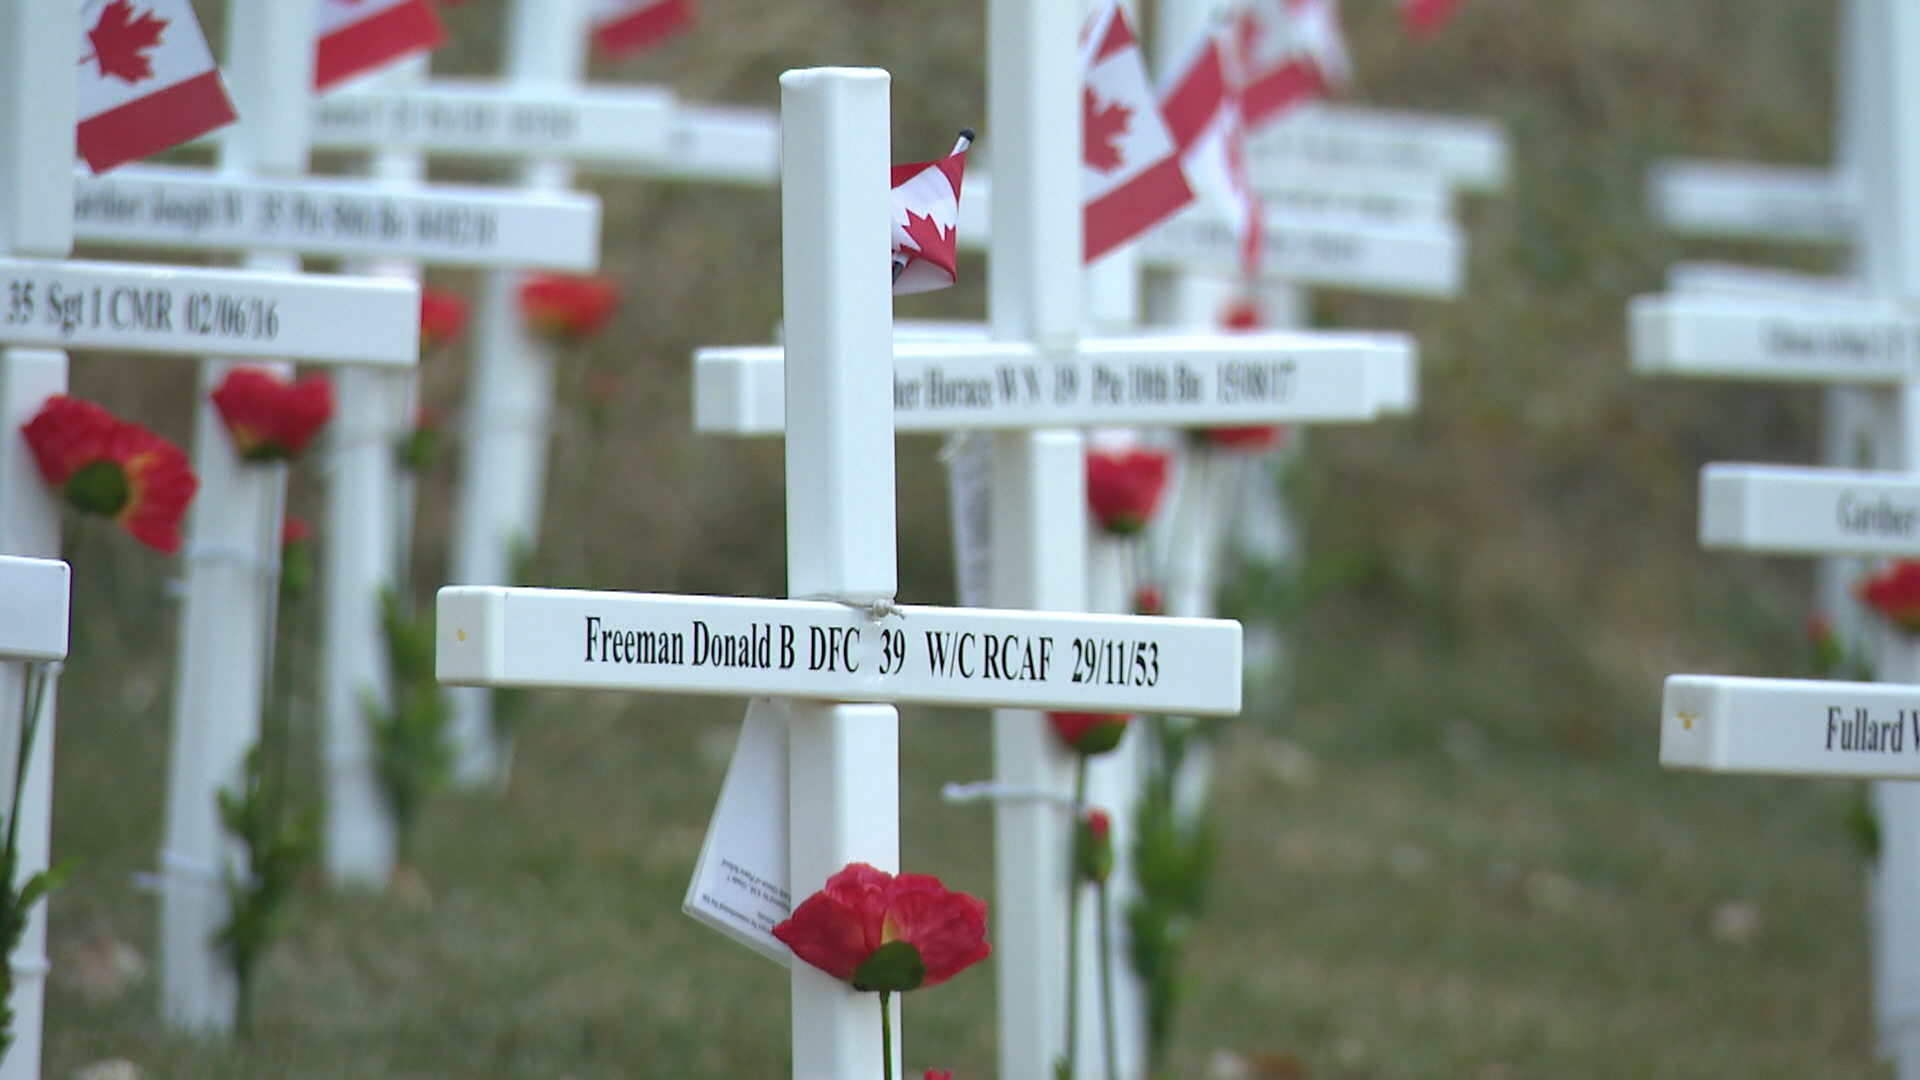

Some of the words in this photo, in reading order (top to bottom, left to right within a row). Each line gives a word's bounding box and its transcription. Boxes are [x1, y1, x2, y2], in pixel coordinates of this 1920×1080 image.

[8, 280, 35, 324] 35
[46, 282, 84, 337] Sgt
[110, 286, 173, 332] CMR
[187, 291, 280, 339] 02/06/16
[585, 615, 685, 665] Freeman
[691, 620, 772, 669] Donald
[778, 624, 796, 670] B
[808, 625, 861, 673] DFC
[879, 628, 907, 676] 39
[925, 630, 976, 679] W/C
[982, 633, 1054, 682] RCAF
[1071, 637, 1160, 687] 29/11/53
[1825, 704, 1905, 754] Fullard
